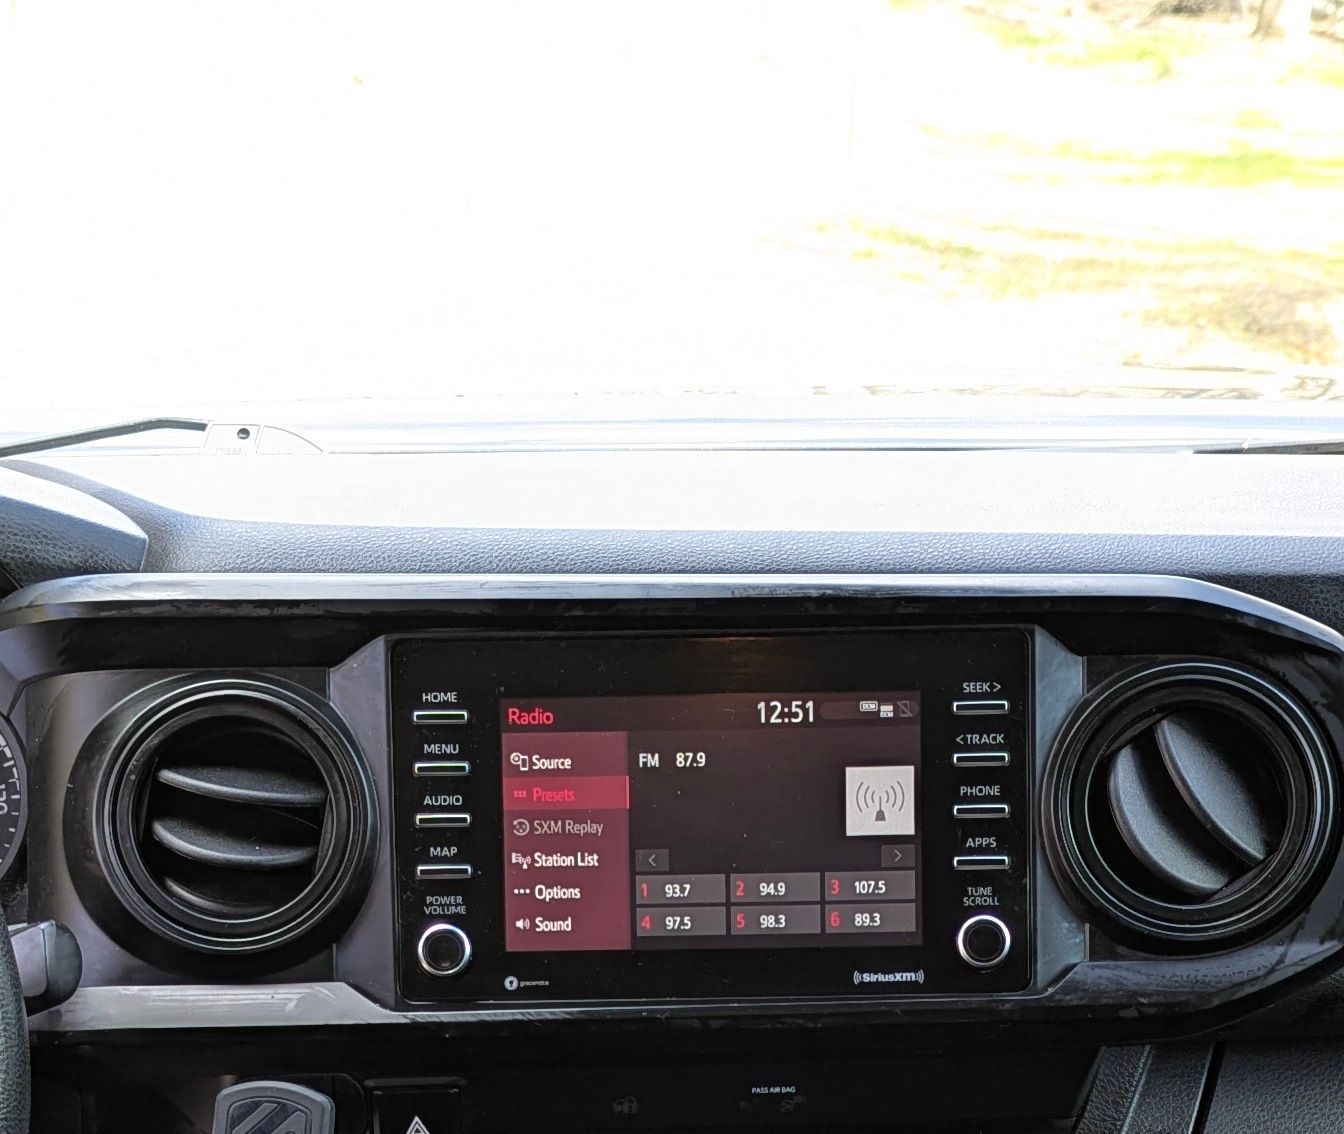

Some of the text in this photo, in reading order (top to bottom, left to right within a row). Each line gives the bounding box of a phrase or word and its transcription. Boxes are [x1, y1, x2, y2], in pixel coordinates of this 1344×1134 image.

[422, 692, 458, 703] HOME
[508, 708, 554, 725] Radio
[756, 701, 816, 723] 12:51
[424, 743, 459, 754] MENU
[532, 755, 572, 770] Source
[639, 752, 706, 768] FM 87.9
[533, 788, 575, 802] Presets
[960, 785, 1001, 796] PHONE
[423, 795, 463, 806] AUDIO
[533, 819, 604, 837] SXM Replay
[965, 837, 997, 848] APPS
[430, 847, 458, 857] MAP
[534, 852, 599, 868] Station List
[534, 885, 581, 901] Options
[641, 883, 691, 898] 1 93.7
[736, 882, 786, 896] 2 94.9
[830, 880, 886, 895] 3 107.5
[967, 887, 993, 896] TUNE
[426, 896, 463, 905] POWER
[963, 896, 1000, 906] SCROLL
[424, 905, 467, 915] VOLUME
[535, 917, 572, 932] Sound
[641, 915, 692, 930] 4 97.5
[736, 914, 786, 929] 5 98.3
[830, 912, 881, 927] 6 89.3
